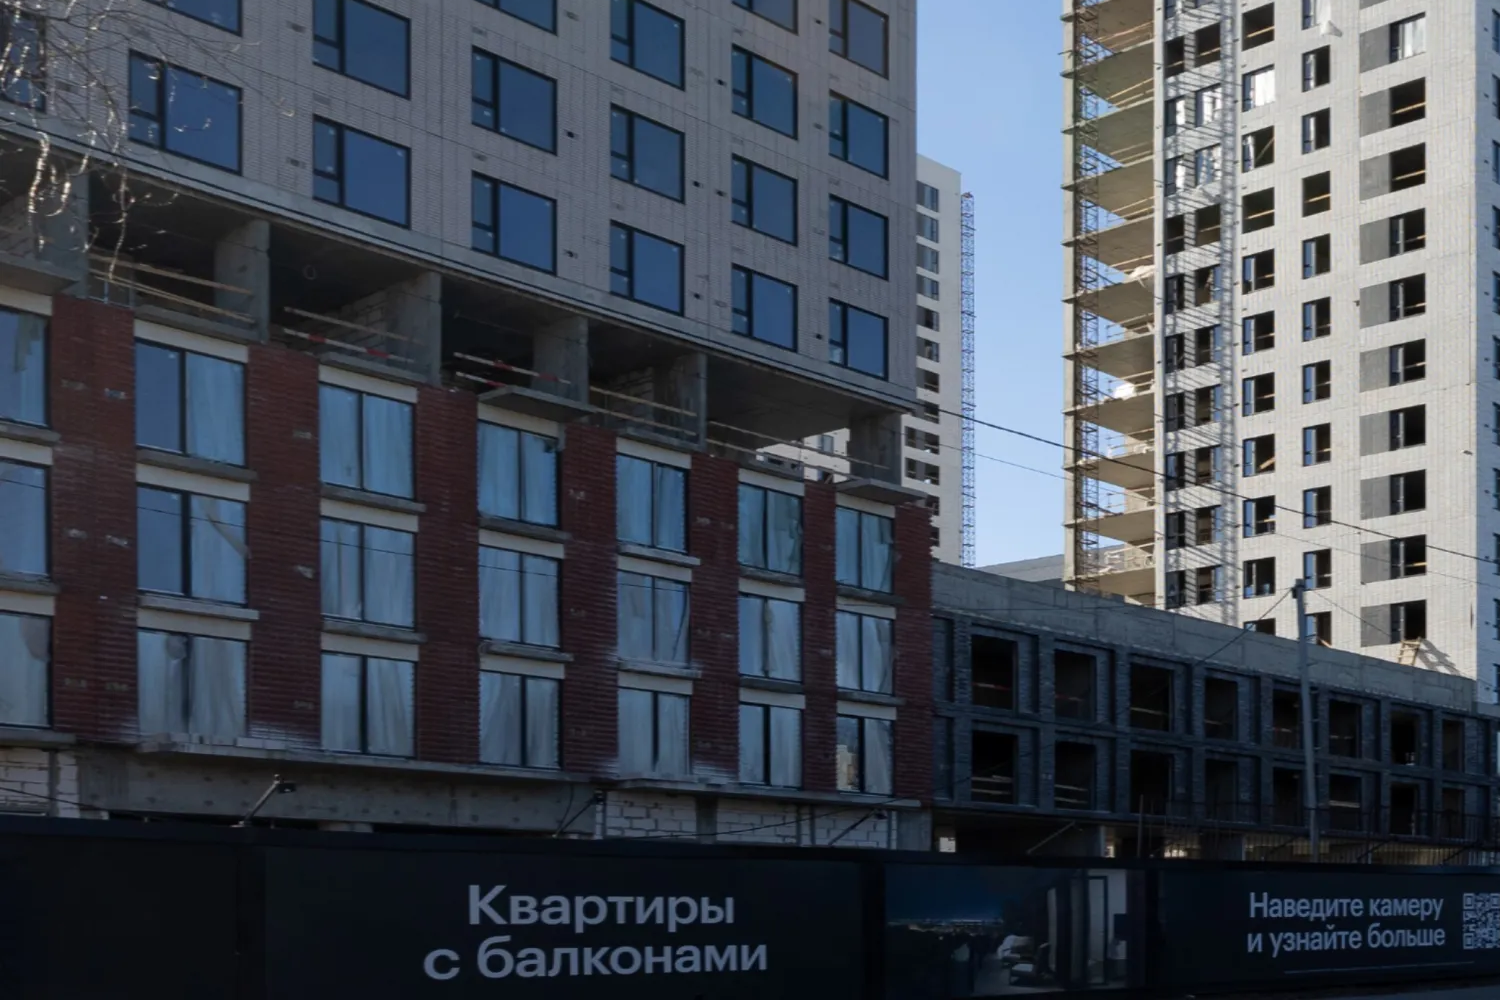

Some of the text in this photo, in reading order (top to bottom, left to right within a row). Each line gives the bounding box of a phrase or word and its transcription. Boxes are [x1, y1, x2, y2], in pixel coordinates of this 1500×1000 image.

[468, 883, 735, 934] Квартиры
[1248, 891, 1444, 921] Наведите камеру
[423, 935, 768, 981] с балконами
[1246, 922, 1446, 959] и узнайте больше
